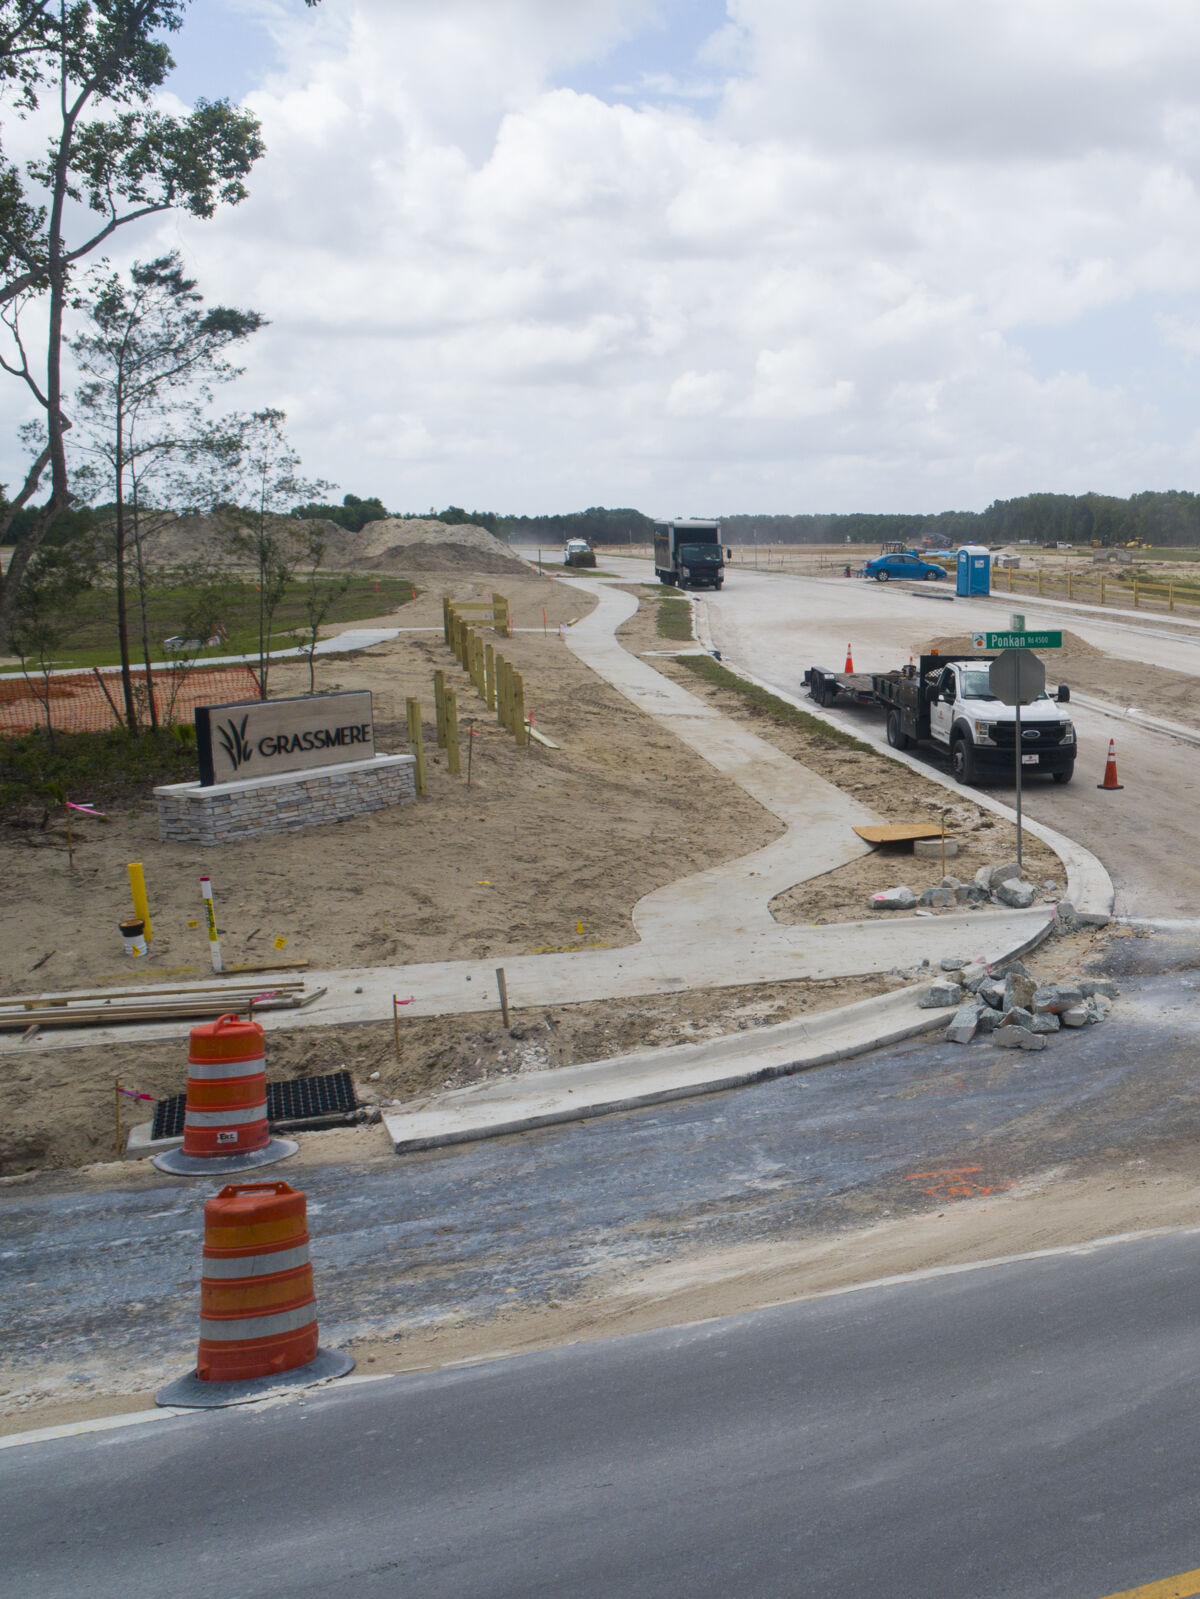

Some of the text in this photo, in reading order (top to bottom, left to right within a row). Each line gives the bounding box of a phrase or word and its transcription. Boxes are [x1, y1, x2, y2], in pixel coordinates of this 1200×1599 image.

[991, 634, 1025, 647] Ponkan
[1035, 636, 1048, 644] 4500
[258, 724, 372, 757] GRASSMERE
